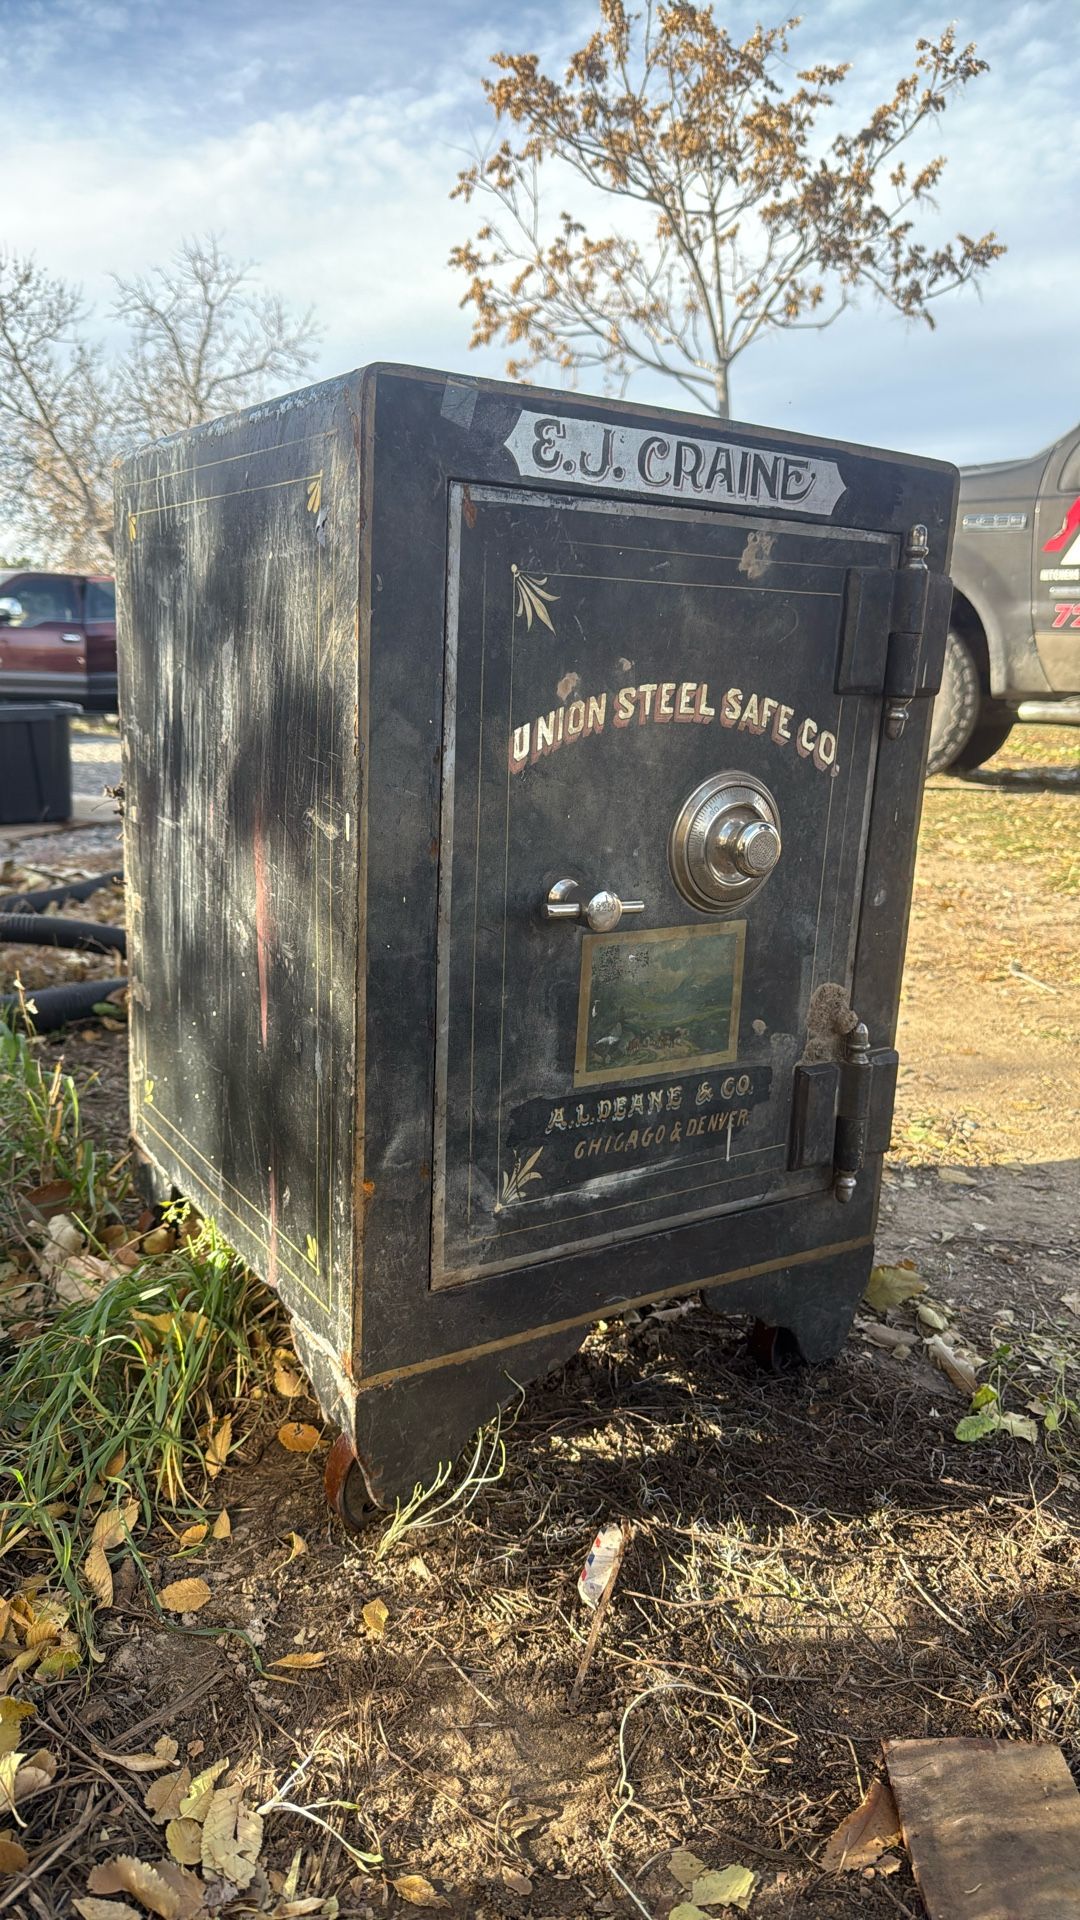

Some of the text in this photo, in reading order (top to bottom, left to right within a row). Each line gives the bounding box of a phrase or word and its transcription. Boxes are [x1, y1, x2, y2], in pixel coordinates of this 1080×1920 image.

[531, 418, 816, 503] E.J. CRAINE
[508, 693, 607, 774] UNION
[613, 682, 715, 728] STEEL
[720, 688, 794, 746] SAFE
[695, 1081, 713, 1105] &
[574, 1124, 666, 1159] CHICAGO
[669, 1121, 682, 1142] &
